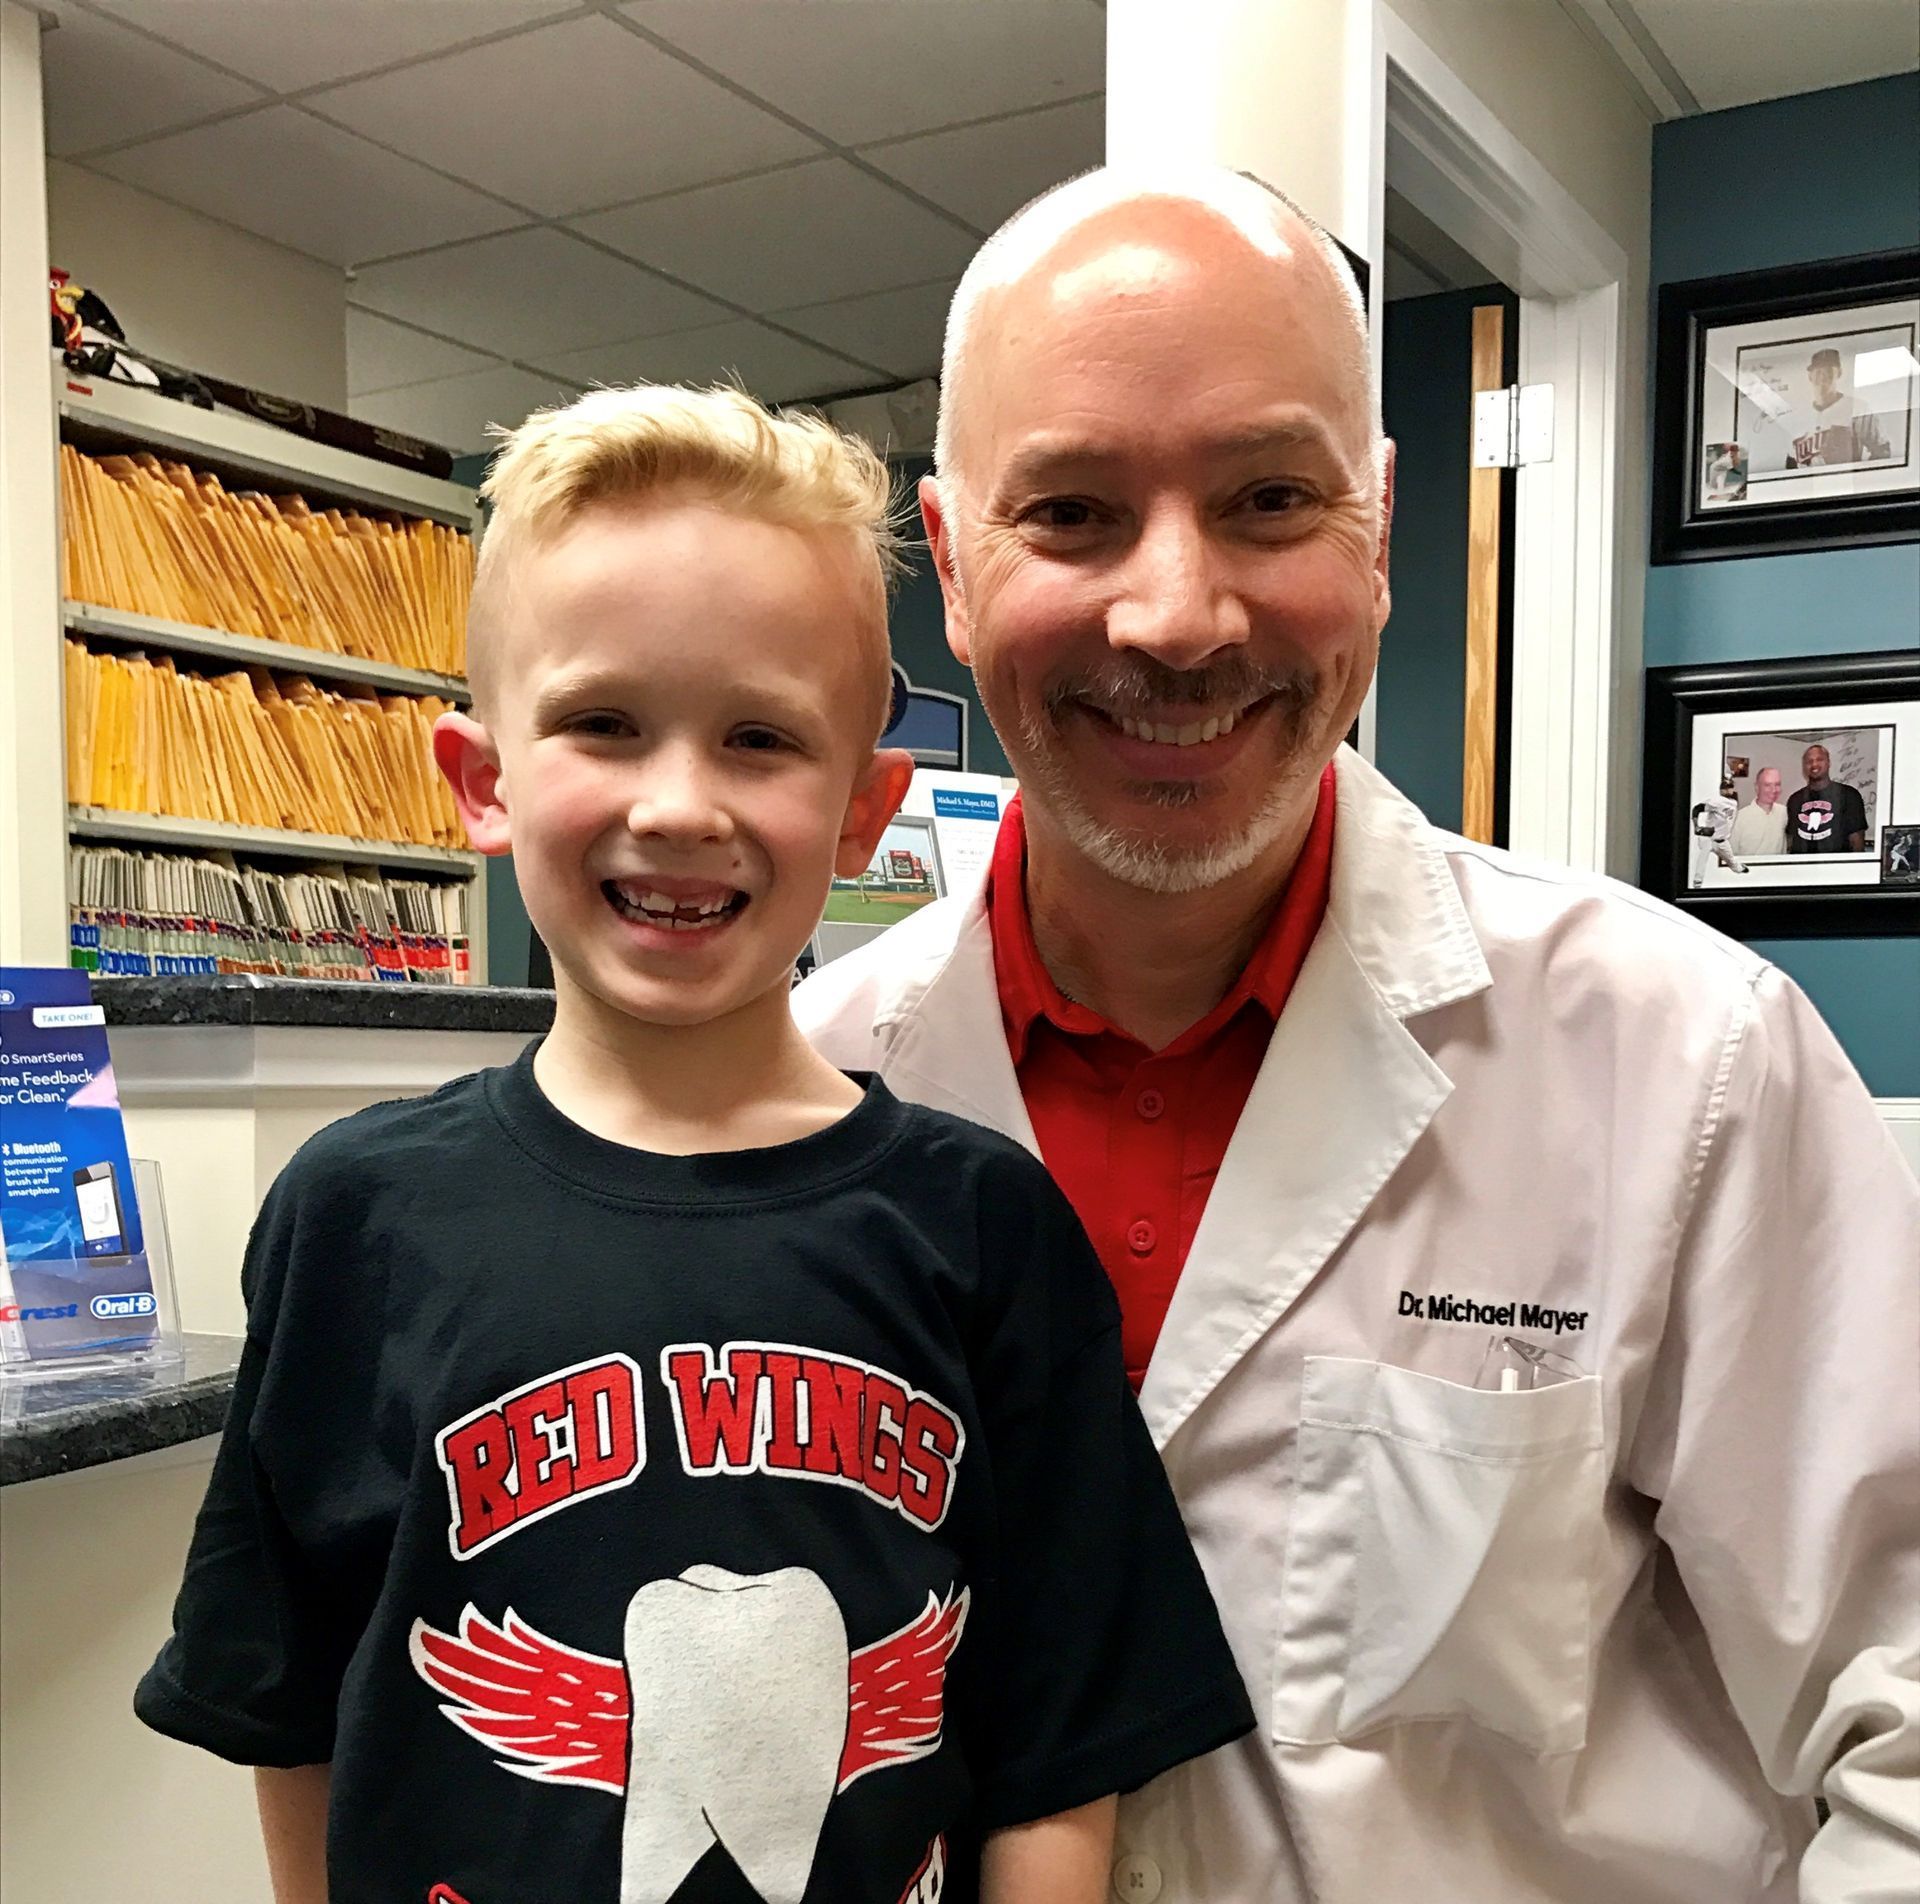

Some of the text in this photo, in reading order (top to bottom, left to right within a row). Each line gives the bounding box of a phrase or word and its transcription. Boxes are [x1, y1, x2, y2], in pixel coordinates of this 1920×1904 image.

[41, 1013, 93, 1023] TAKE ONE!
[11, 1052, 85, 1065] SmartSeries
[22, 1068, 95, 1086] Feedback
[12, 1141, 62, 1156] Bluetooth
[3, 1155, 69, 1167] communication
[4, 1166, 64, 1177] between your
[5, 1175, 50, 1187] brush and
[8, 1186, 61, 1198] smartphone
[94, 1295, 153, 1316] Oral-B
[1399, 1290, 1589, 1336] Dr. Michael Mayer
[434, 1339, 967, 1562] RED WINGS
